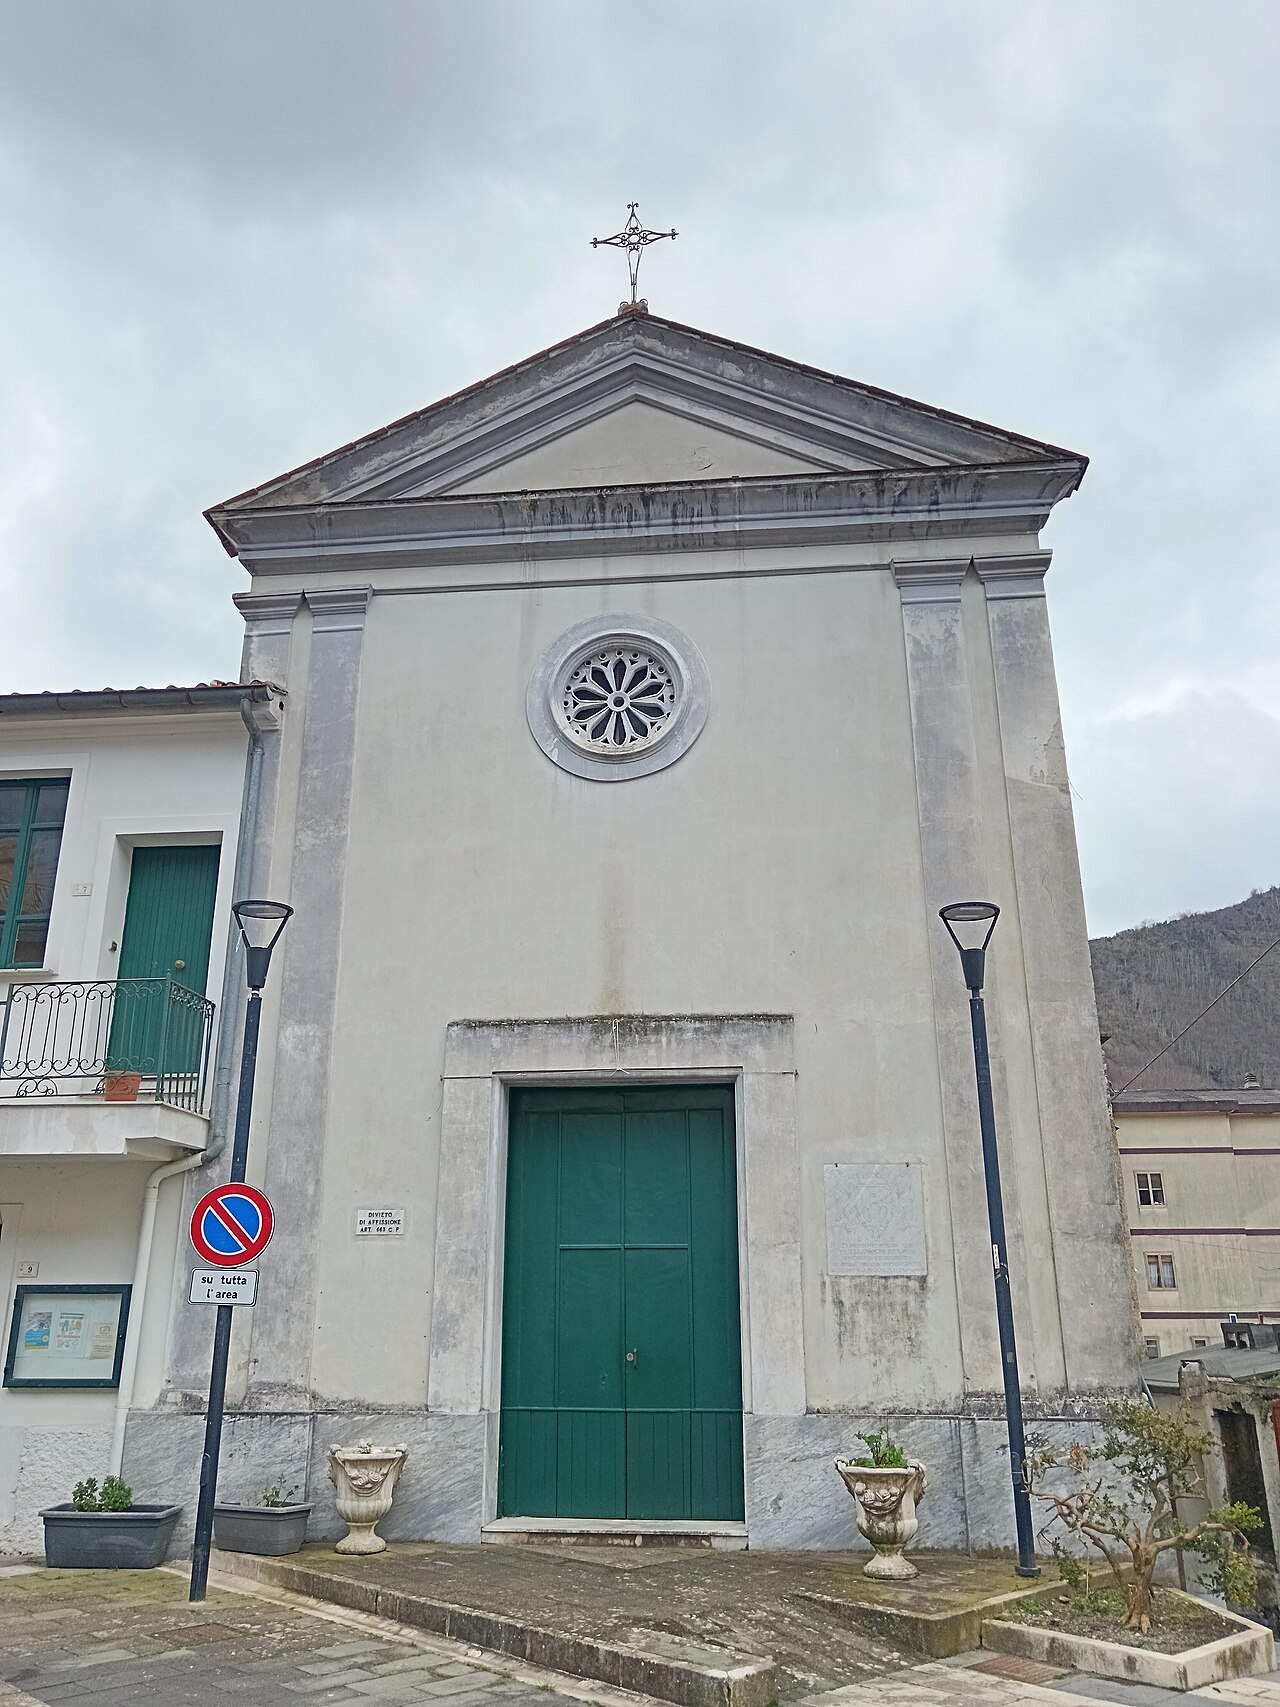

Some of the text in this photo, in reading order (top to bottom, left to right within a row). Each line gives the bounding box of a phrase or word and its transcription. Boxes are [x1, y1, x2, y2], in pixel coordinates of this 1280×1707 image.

[27, 1265, 33, 1273] 9
[201, 1275, 247, 1285] su tutta
